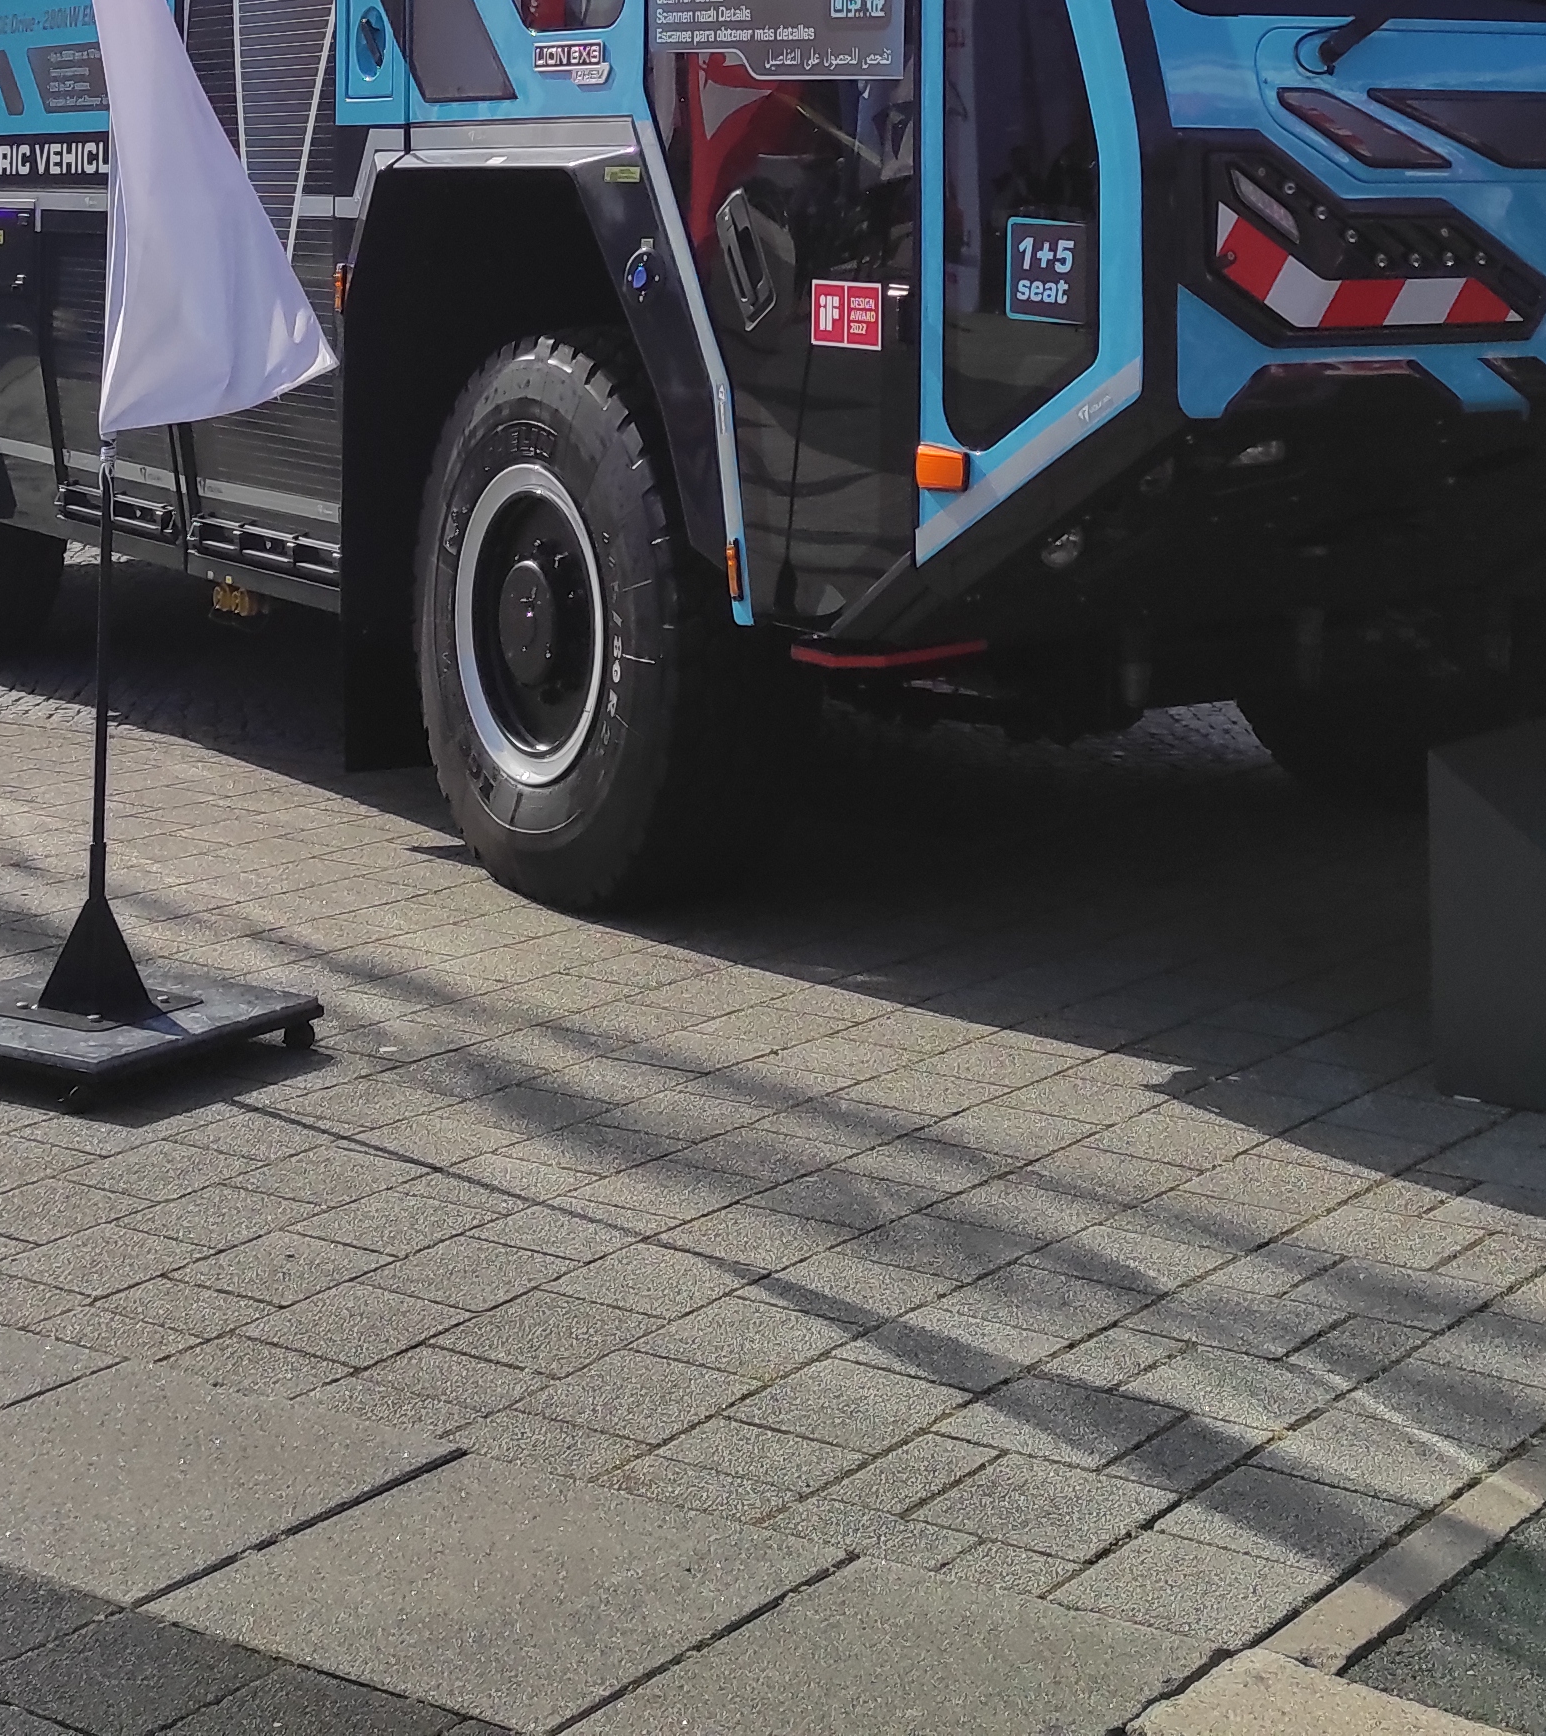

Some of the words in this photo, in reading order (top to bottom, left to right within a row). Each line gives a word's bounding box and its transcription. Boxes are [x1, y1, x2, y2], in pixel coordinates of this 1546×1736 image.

[656, 8, 693, 24] Scannen
[718, 6, 751, 22] Details
[693, 29, 713, 46] para
[716, 28, 752, 42] obtener
[754, 26, 775, 41] más
[776, 24, 815, 40] detalles
[535, 47, 568, 65] LION
[35, 142, 109, 174] VEHICL
[1018, 236, 1075, 274] 1+5
[1016, 279, 1069, 304] seat
[850, 297, 876, 310] DESIGN
[850, 310, 876, 322] AWARD
